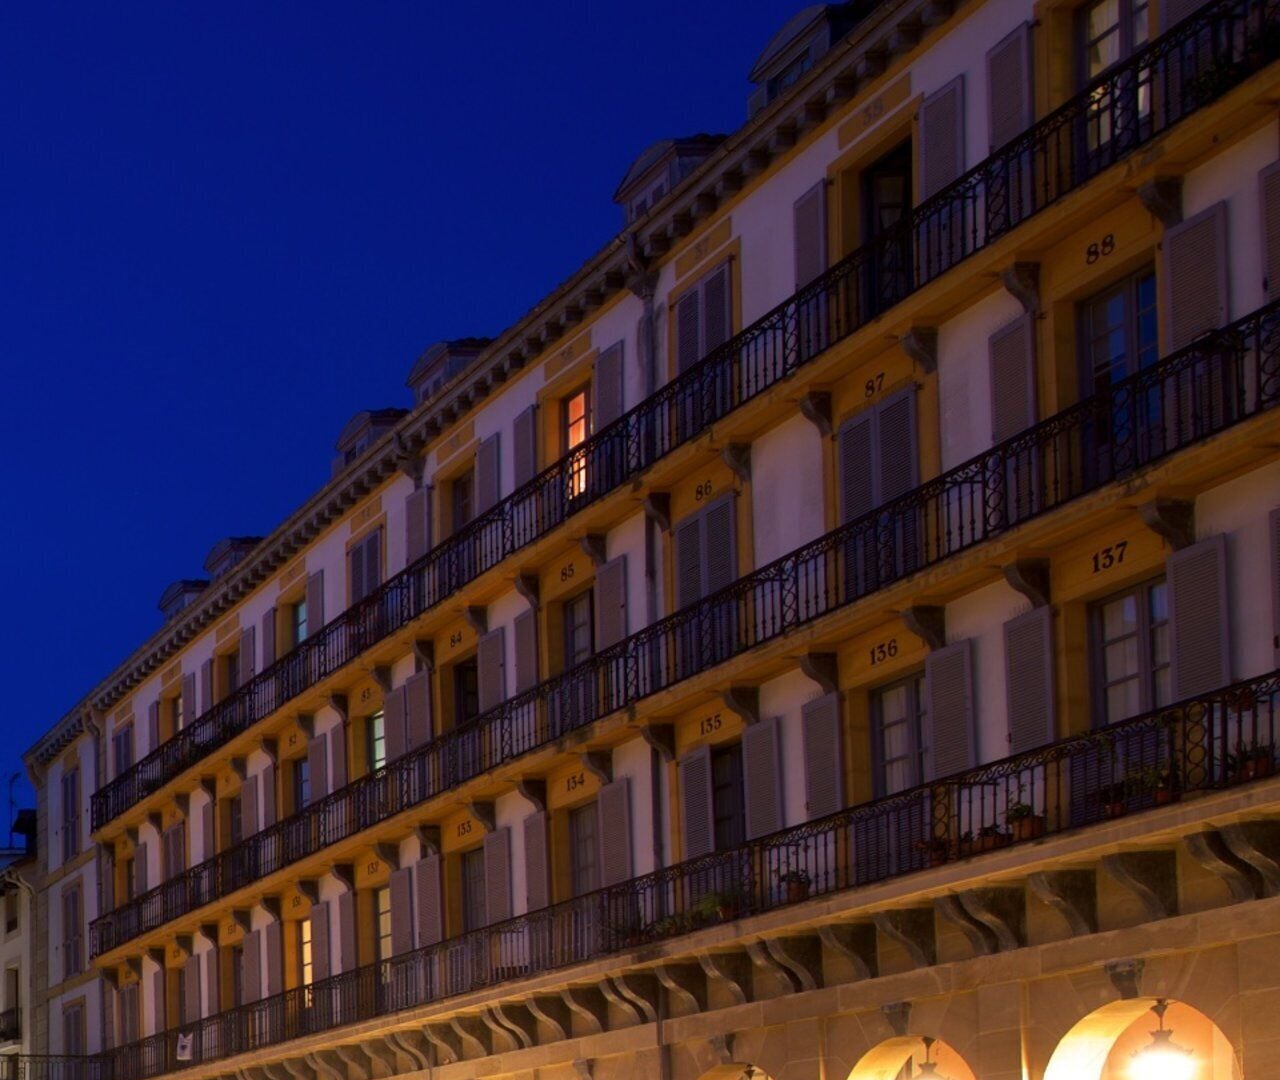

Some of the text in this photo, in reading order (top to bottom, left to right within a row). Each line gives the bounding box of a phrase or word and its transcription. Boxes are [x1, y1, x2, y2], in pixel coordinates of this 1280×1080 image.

[1086, 234, 1115, 264] 88
[865, 372, 885, 397] 87
[696, 480, 712, 500] 86
[1092, 541, 1128, 573] 137
[561, 563, 574, 581] 85
[870, 639, 897, 665] 136
[701, 714, 721, 735] 135
[567, 773, 585, 791] 134
[457, 820, 471, 837] 133
